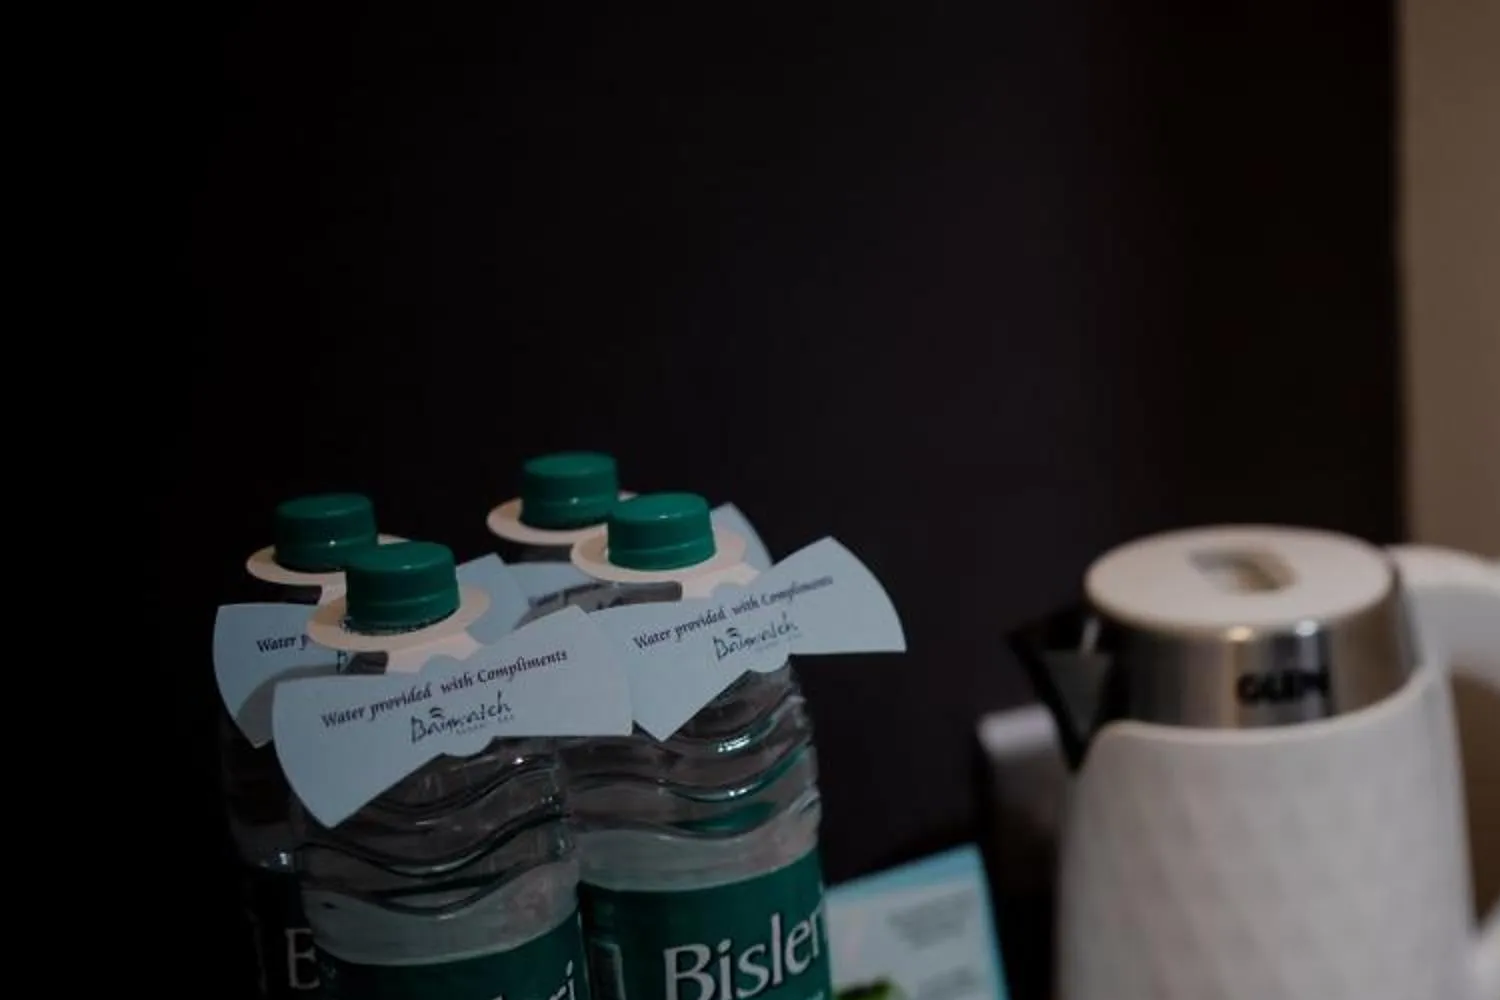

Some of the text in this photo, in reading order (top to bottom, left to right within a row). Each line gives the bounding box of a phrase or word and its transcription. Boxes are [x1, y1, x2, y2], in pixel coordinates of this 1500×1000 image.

[256, 635, 297, 653] Water
[633, 628, 672, 648] Water
[674, 605, 727, 641] provided
[731, 595, 760, 616] with
[321, 649, 569, 729] Water provided with Compliments
